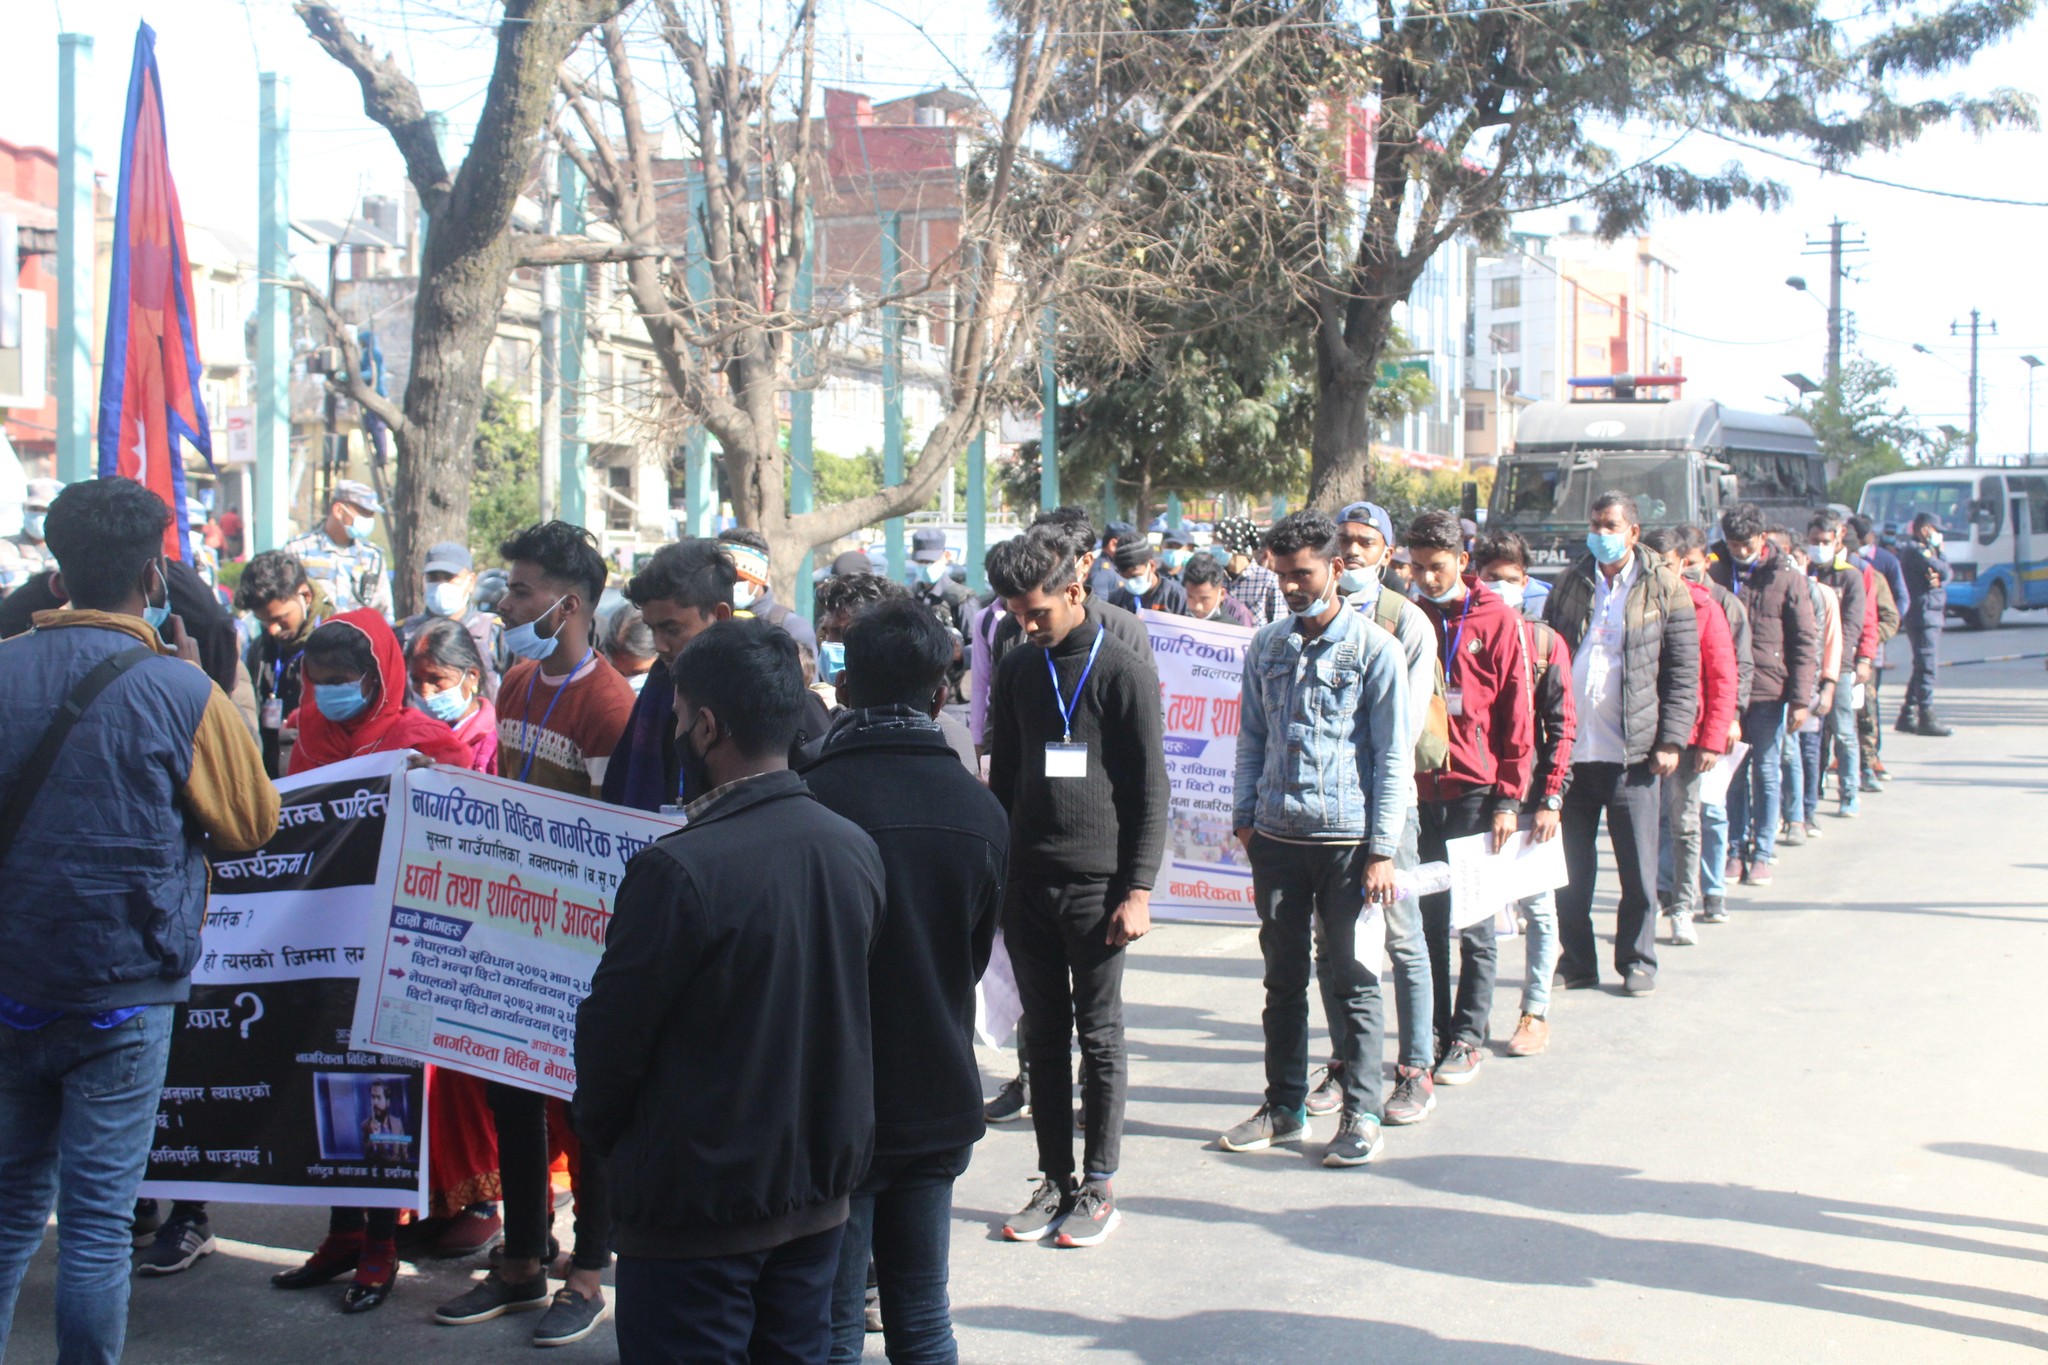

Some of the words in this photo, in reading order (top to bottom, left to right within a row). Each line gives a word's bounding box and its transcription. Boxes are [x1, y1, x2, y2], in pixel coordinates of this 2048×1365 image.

[1528, 549, 1571, 564] EPAL
[1167, 694, 1207, 733] तथा
[412, 786, 500, 832] नागरिकता
[502, 798, 545, 842] विहिन
[547, 817, 611, 859] नागरिक
[1193, 797, 1234, 814] नागरिक
[426, 831, 453, 851] सुस्ता
[528, 853, 579, 879] नवलपरासी
[404, 860, 442, 902] धर्ना
[446, 872, 483, 910] तथा
[486, 874, 558, 937] शान्तिपूर्ण
[562, 898, 615, 945] आन्दो
[1169, 880, 1242, 902] नागरिकता
[221, 948, 274, 971] त्यसको
[281, 945, 336, 966] जिम्मा
[414, 936, 467, 958] नेपालको
[516, 962, 548, 982] २०७२
[550, 971, 571, 987] भाग
[409, 969, 457, 991] नेपालको
[503, 995, 533, 1014] २०७२
[535, 1003, 556, 1017] भाग
[442, 961, 473, 977] भन्दा
[503, 974, 566, 1001] कार्यान्वयन
[434, 994, 463, 1011] भन्दा
[490, 1007, 551, 1032] कार्यान्वयन
[433, 1033, 500, 1062] नागरिकता
[503, 1046, 541, 1073] विहिन
